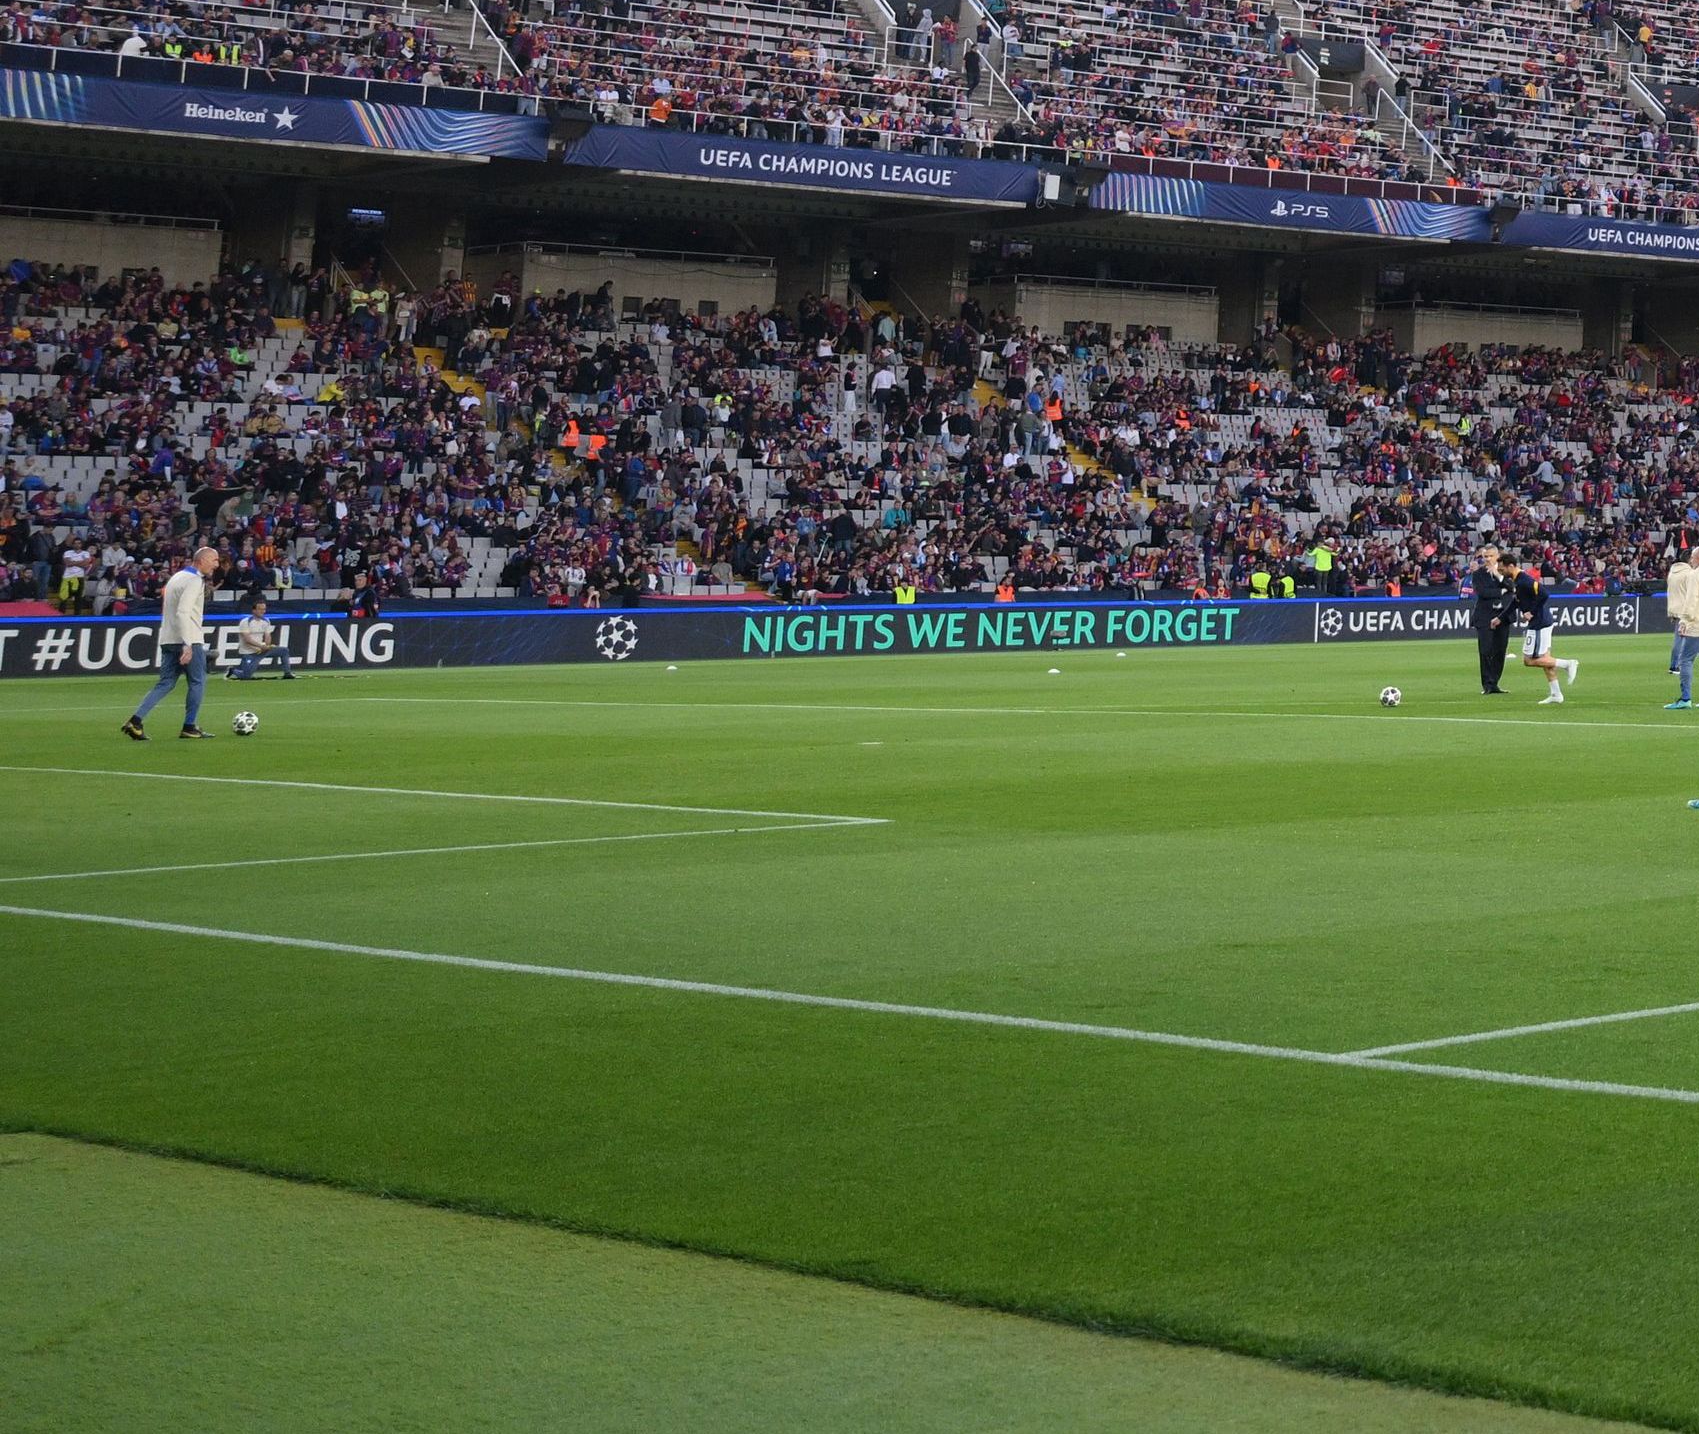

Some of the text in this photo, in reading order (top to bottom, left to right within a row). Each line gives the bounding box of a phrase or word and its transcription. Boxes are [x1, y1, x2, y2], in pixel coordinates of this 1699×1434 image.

[184, 103, 267, 123] Heineken
[700, 148, 953, 186] UEFA CHAMPIONS LEAGUE
[1291, 204, 1329, 218] PS5
[1588, 228, 1623, 244] UEFA
[743, 608, 1240, 653] NIGHTS WE NEVER FORGET
[1349, 610, 1405, 632] UEFA
[1549, 606, 1610, 627] EAGUE
